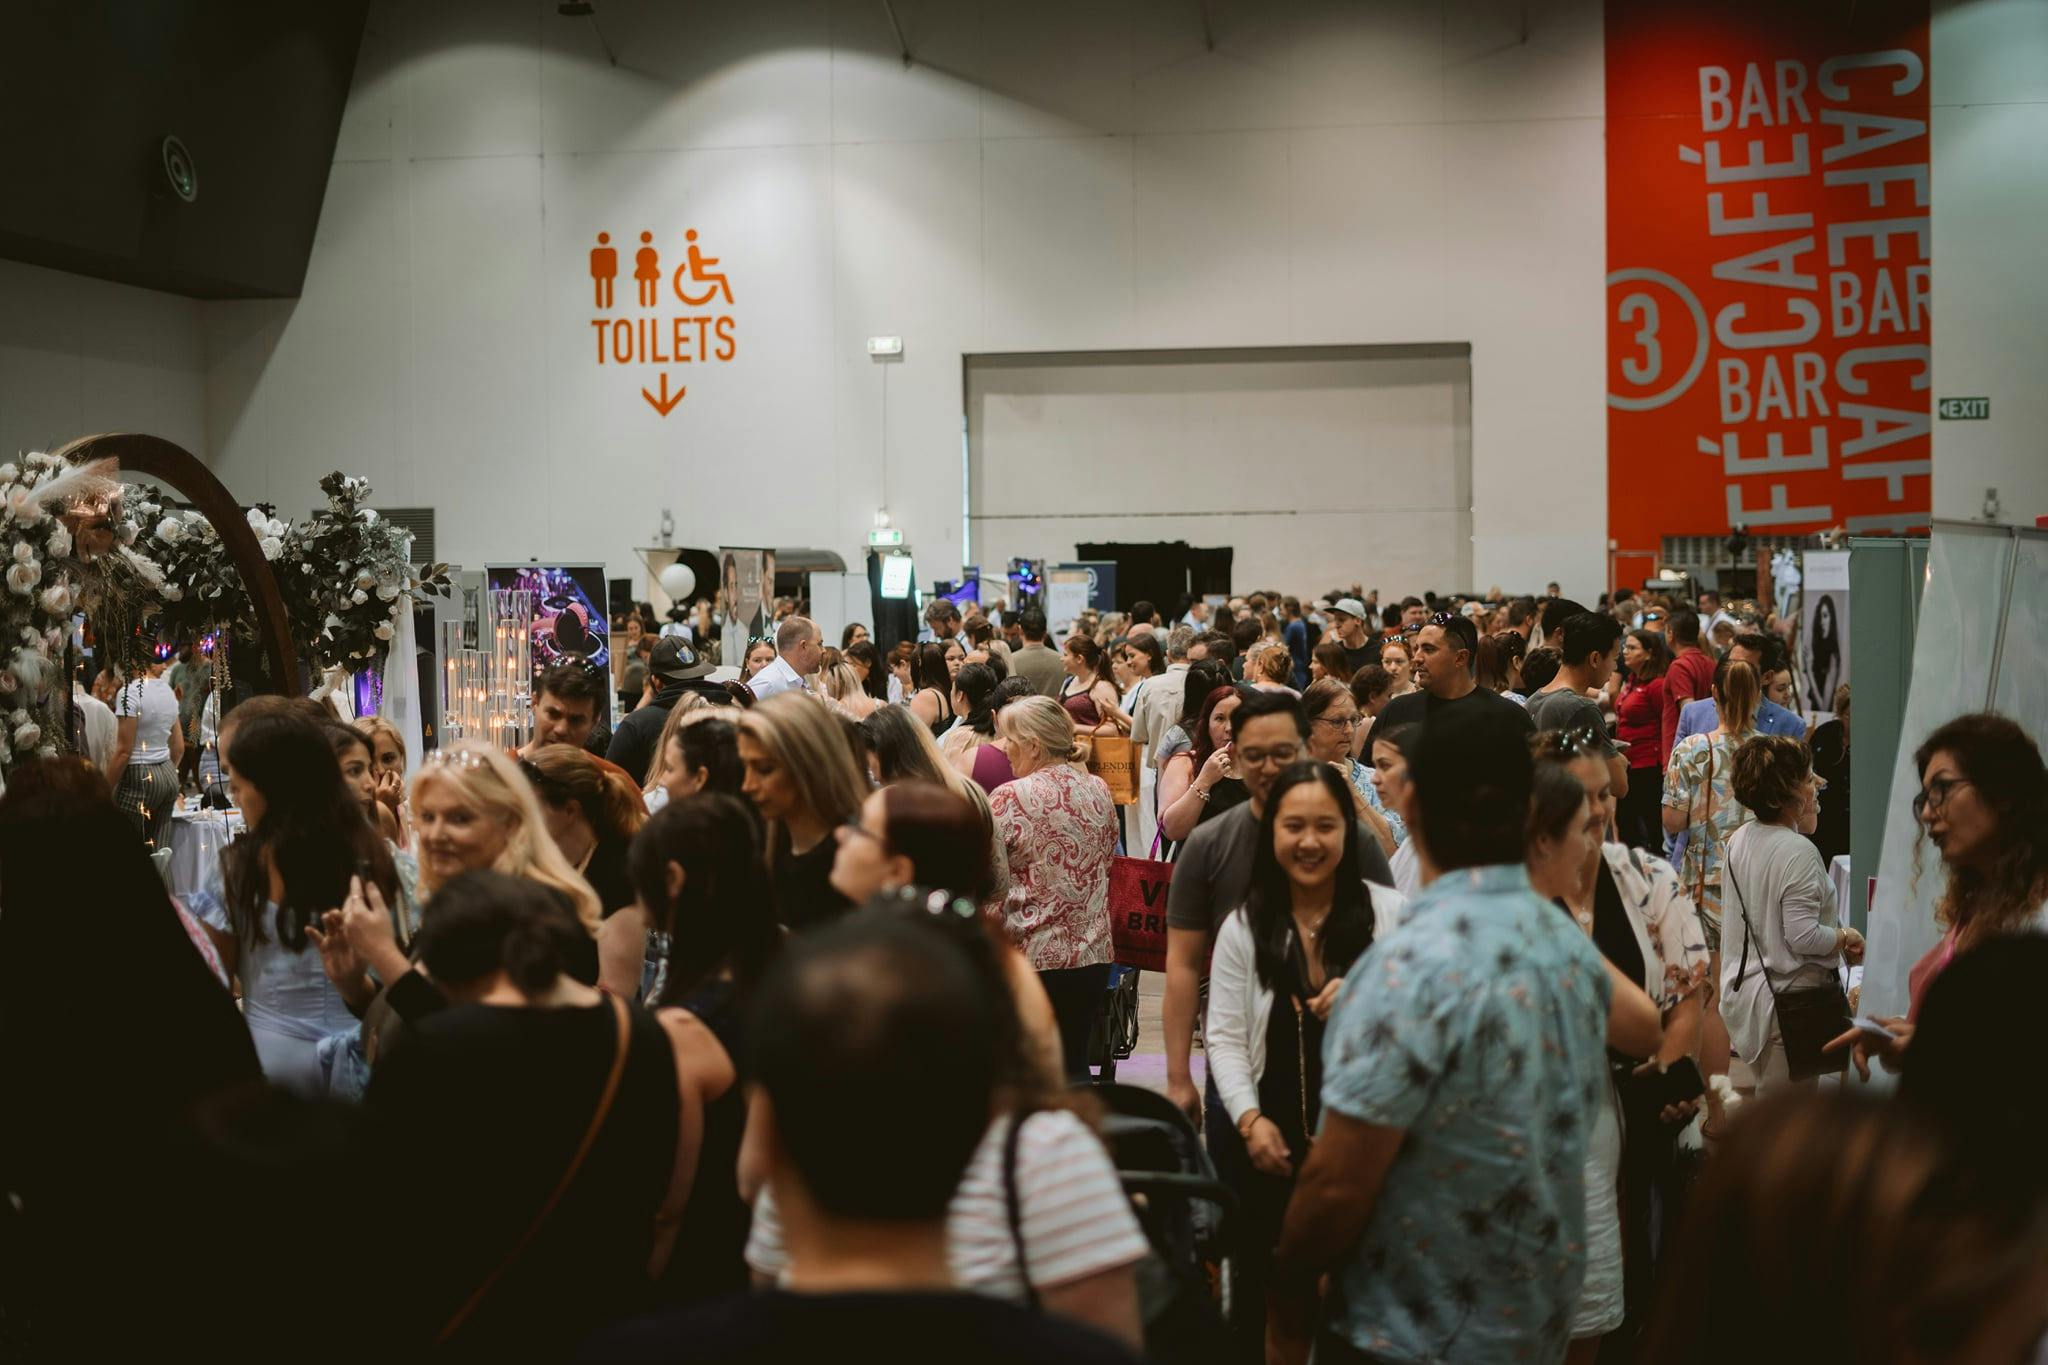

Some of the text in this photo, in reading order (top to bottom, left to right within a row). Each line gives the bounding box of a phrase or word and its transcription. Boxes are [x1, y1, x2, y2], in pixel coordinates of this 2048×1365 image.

[1699, 59, 1812, 132] BAR
[1679, 134, 1821, 349] CAFÉ
[1830, 264, 1931, 338] BAR
[591, 315, 736, 365] TOILETS
[1619, 292, 1662, 385] 3
[1718, 352, 1830, 424] BAR
[1949, 400, 1988, 417] EXIT
[1128, 912, 1167, 933] BR
[1141, 880, 1170, 907] V
